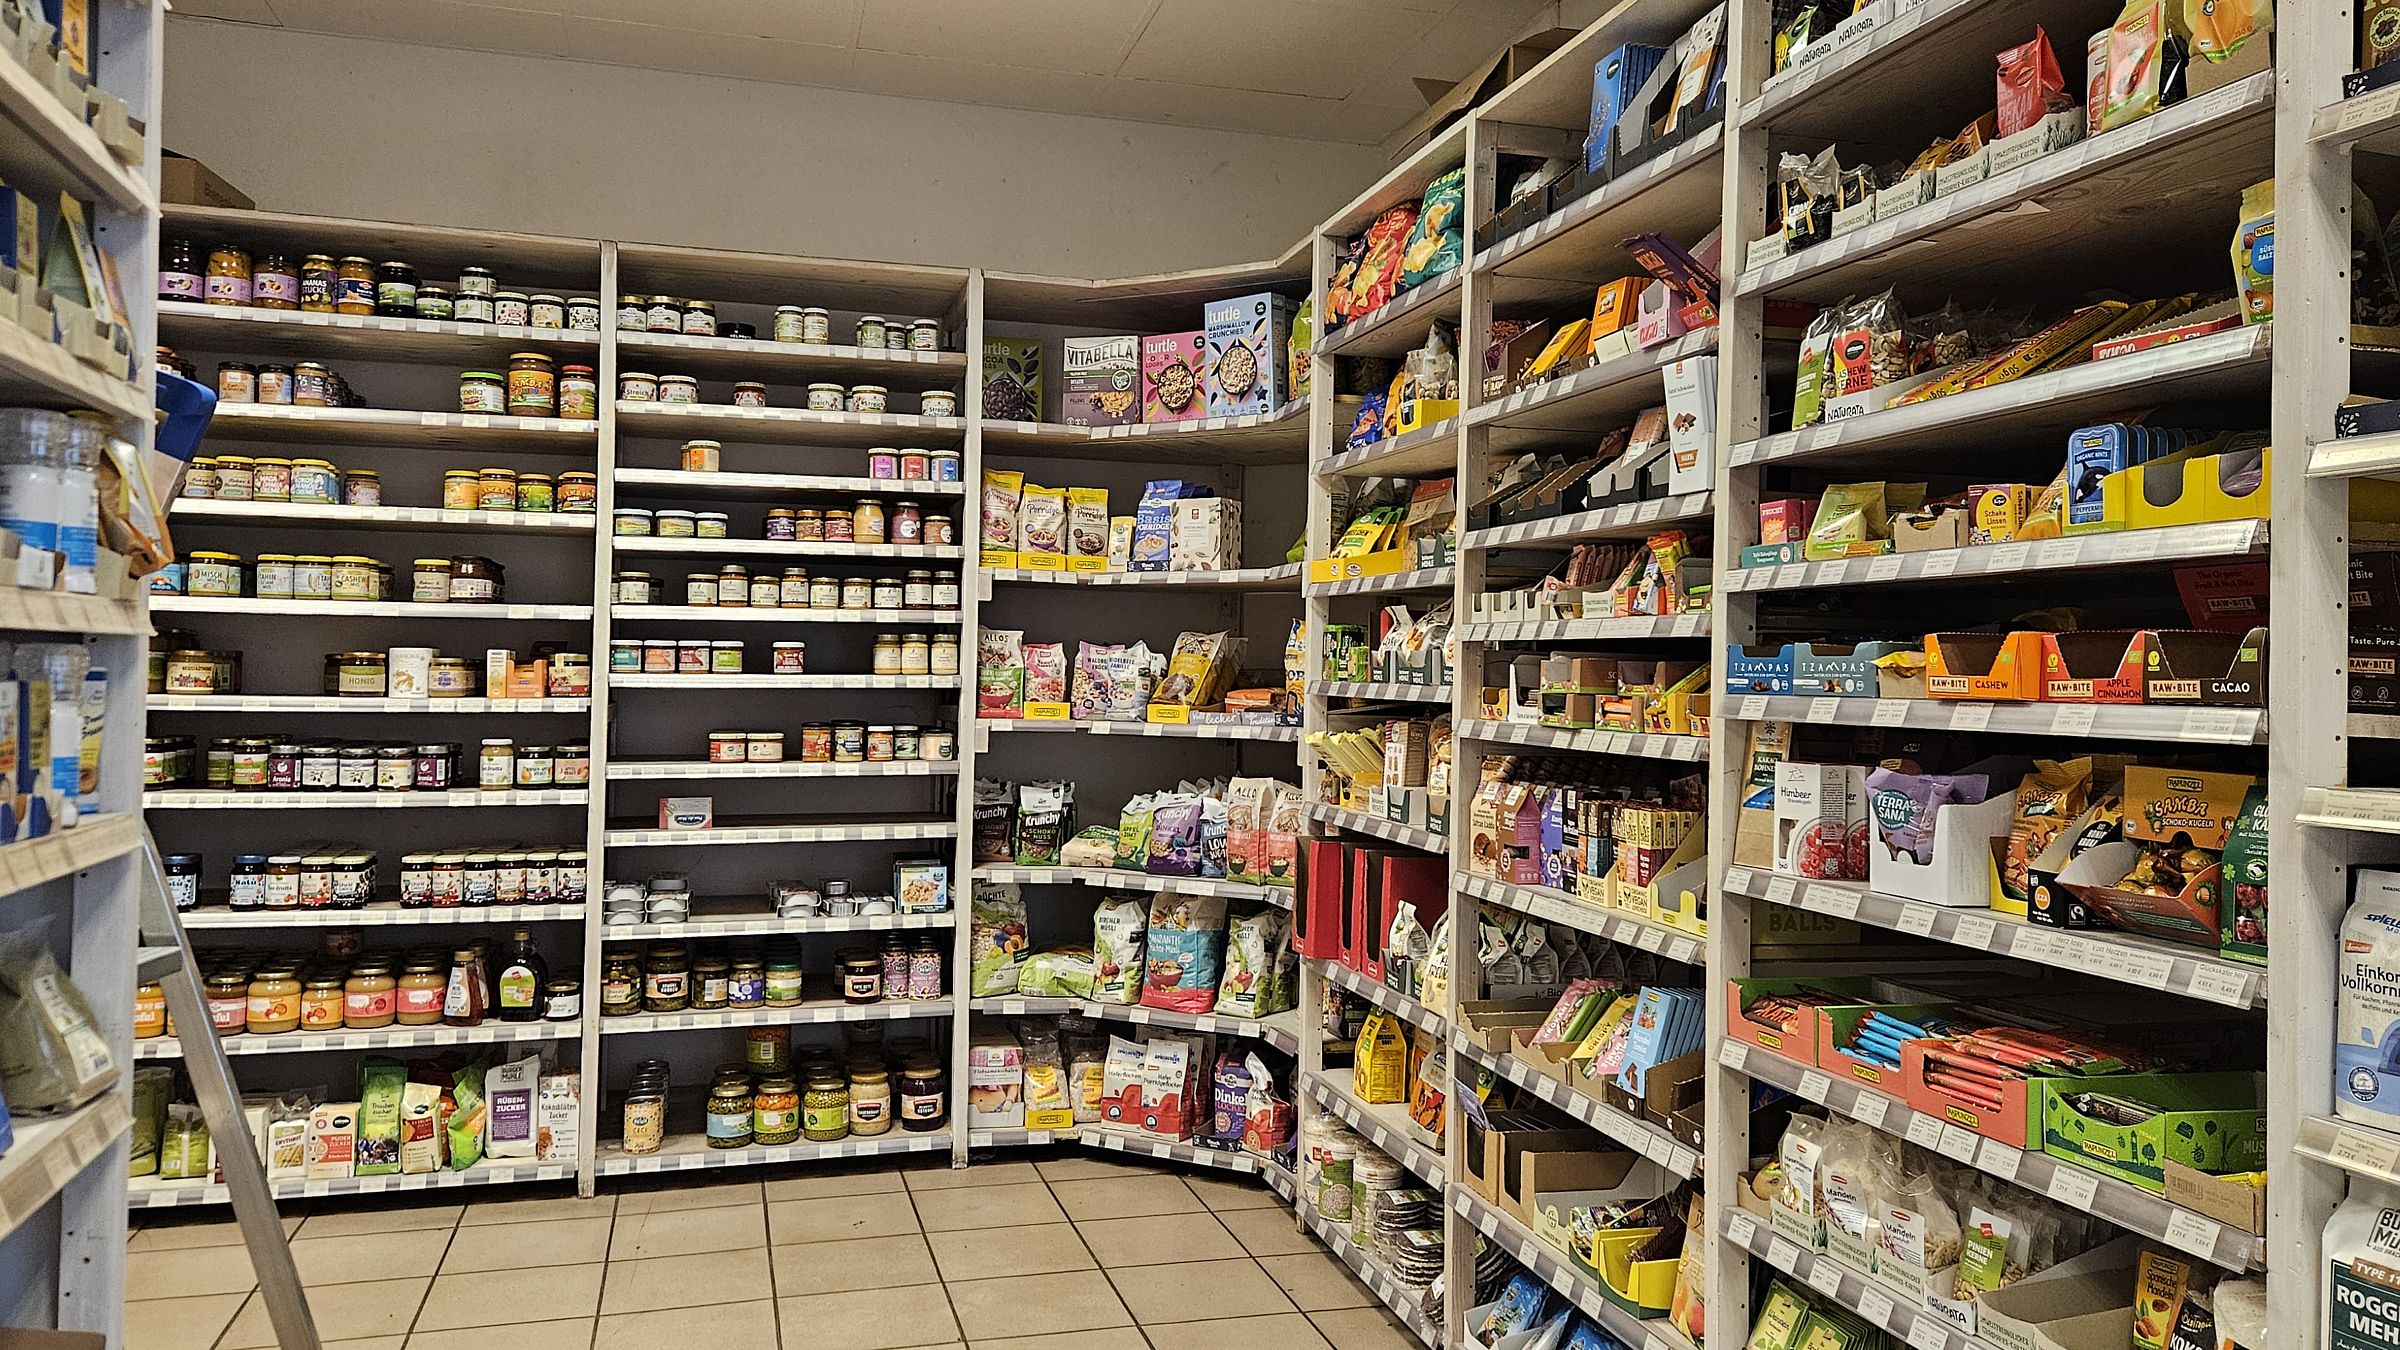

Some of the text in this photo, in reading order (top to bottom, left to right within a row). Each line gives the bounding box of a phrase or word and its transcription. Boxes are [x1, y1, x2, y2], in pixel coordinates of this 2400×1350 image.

[1839, 18, 1873, 45] NATURATA
[1799, 43, 1831, 68] NATURATA
[2255, 223, 2274, 237] RAPUN
[302, 280, 328, 288] ANANAS
[1208, 306, 1240, 324] turtle
[1208, 320, 1251, 332] MARSHMALLOW
[1208, 328, 1244, 340] CRUNCHIES
[1146, 338, 1177, 354] turtle
[1067, 342, 1134, 366] VITABELLA
[1828, 405, 1865, 423] NATURATA
[2076, 451, 2108, 461] ORGANIC MINTS
[1027, 504, 1060, 516] Porridge
[1075, 508, 1107, 520] Porridge
[2076, 504, 2103, 513] PEPPERMIN
[1137, 514, 1172, 524] Basis
[1986, 517, 2007, 525] Linsen
[1136, 523, 1170, 531] PORRIDGE
[201, 571, 223, 579] MISCH
[259, 573, 277, 581] TAHIN
[985, 633, 1009, 643] ALLOS
[2376, 637, 2395, 646] Pure
[349, 676, 375, 685] HONIG
[1975, 680, 2009, 690] CASHEW
[2107, 679, 2131, 689] APPLE
[2097, 689, 2141, 699] CINNAMON
[2211, 682, 2251, 694] CACAO
[272, 775, 292, 783] Aronia
[2168, 778, 2202, 791] RAPUNZEL
[1780, 786, 1812, 801] Himbeer
[1876, 793, 1911, 812] TERRA
[2154, 797, 2209, 818] SAMBA
[974, 806, 1008, 820] Krunchy
[1025, 812, 1061, 827] Krunchy
[1878, 807, 1906, 822] SANA
[1203, 823, 1227, 837] Krunc
[2162, 818, 2214, 829] SCHOKO-KUGELN
[1778, 861, 1788, 870] bio
[1588, 885, 1605, 898] VEGAN
[1631, 894, 1648, 907] VEGAN
[1769, 914, 1839, 933] BALLS
[2356, 964, 2400, 983] Einkor
[1542, 1001, 1571, 1038] KROKANT
[1588, 1022, 1612, 1051] CRISPY
[1758, 1032, 1781, 1048] RAPUNZEL
[1158, 1073, 1172, 1081] Hafer
[1853, 1064, 1881, 1083] RAPUNZEL
[497, 1096, 525, 1104] RÜBEN-
[496, 1104, 526, 1112] ZUCKER
[549, 1111, 569, 1119] Zucker
[1037, 1115, 1063, 1124] RAPUNZEL
[1946, 1107, 1979, 1127] RAPUNZEL
[2084, 1142, 2117, 1161] RAPUNZEL
[2243, 1138, 2267, 1154] MÜS
[1826, 1187, 1857, 1202] Mandeln
[1886, 1224, 1917, 1242] Mandeln
[1967, 1240, 1993, 1258] PINIEN
[1966, 1250, 1988, 1267] KERNE
[2356, 1261, 2385, 1281] TYPE
[2146, 1270, 2177, 1289] Spanische
[2146, 1283, 2174, 1301] Mandeln
[1927, 1295, 1967, 1325] NATURATA
[2350, 1310, 2400, 1346] MEH
